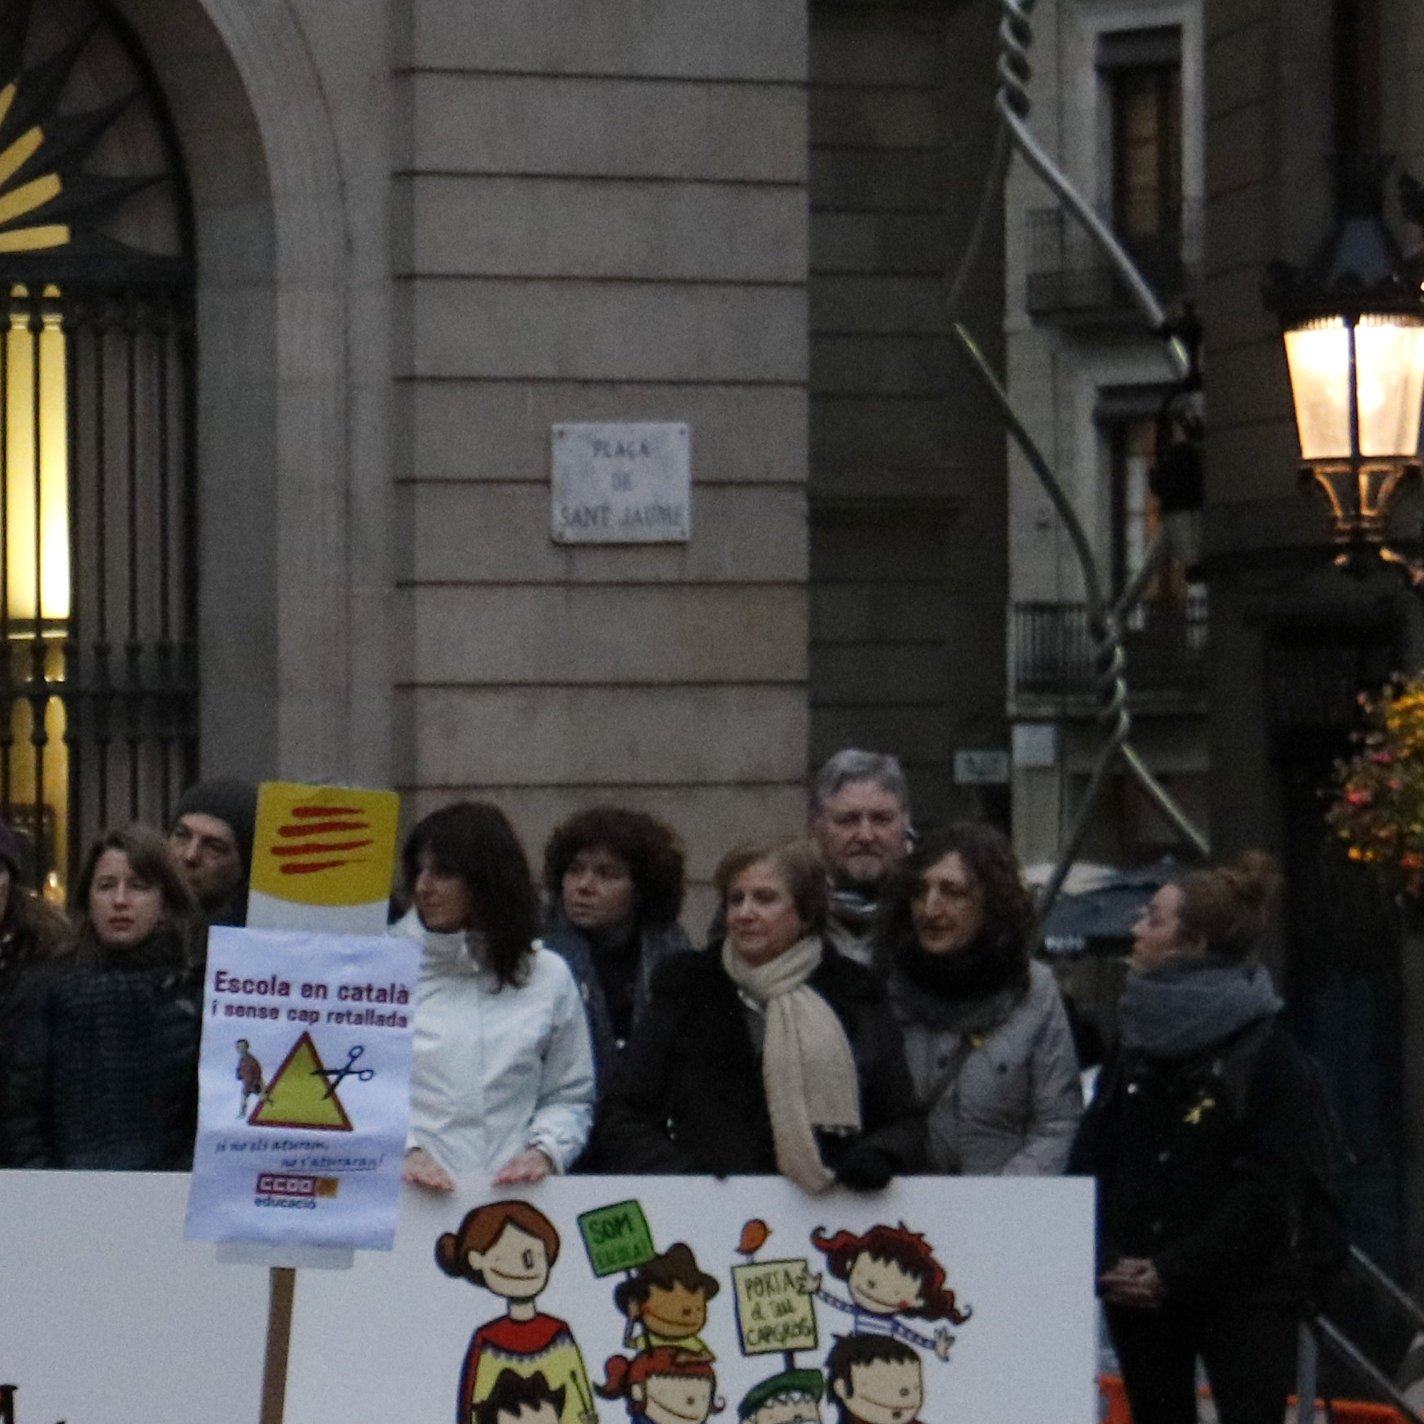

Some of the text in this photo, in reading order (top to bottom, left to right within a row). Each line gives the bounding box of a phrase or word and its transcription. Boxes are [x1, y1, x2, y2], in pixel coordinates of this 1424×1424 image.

[214, 971, 409, 1005] Escola en català
[212, 1001, 408, 1028] i sense cap retallada
[254, 1196, 316, 1210] educació
